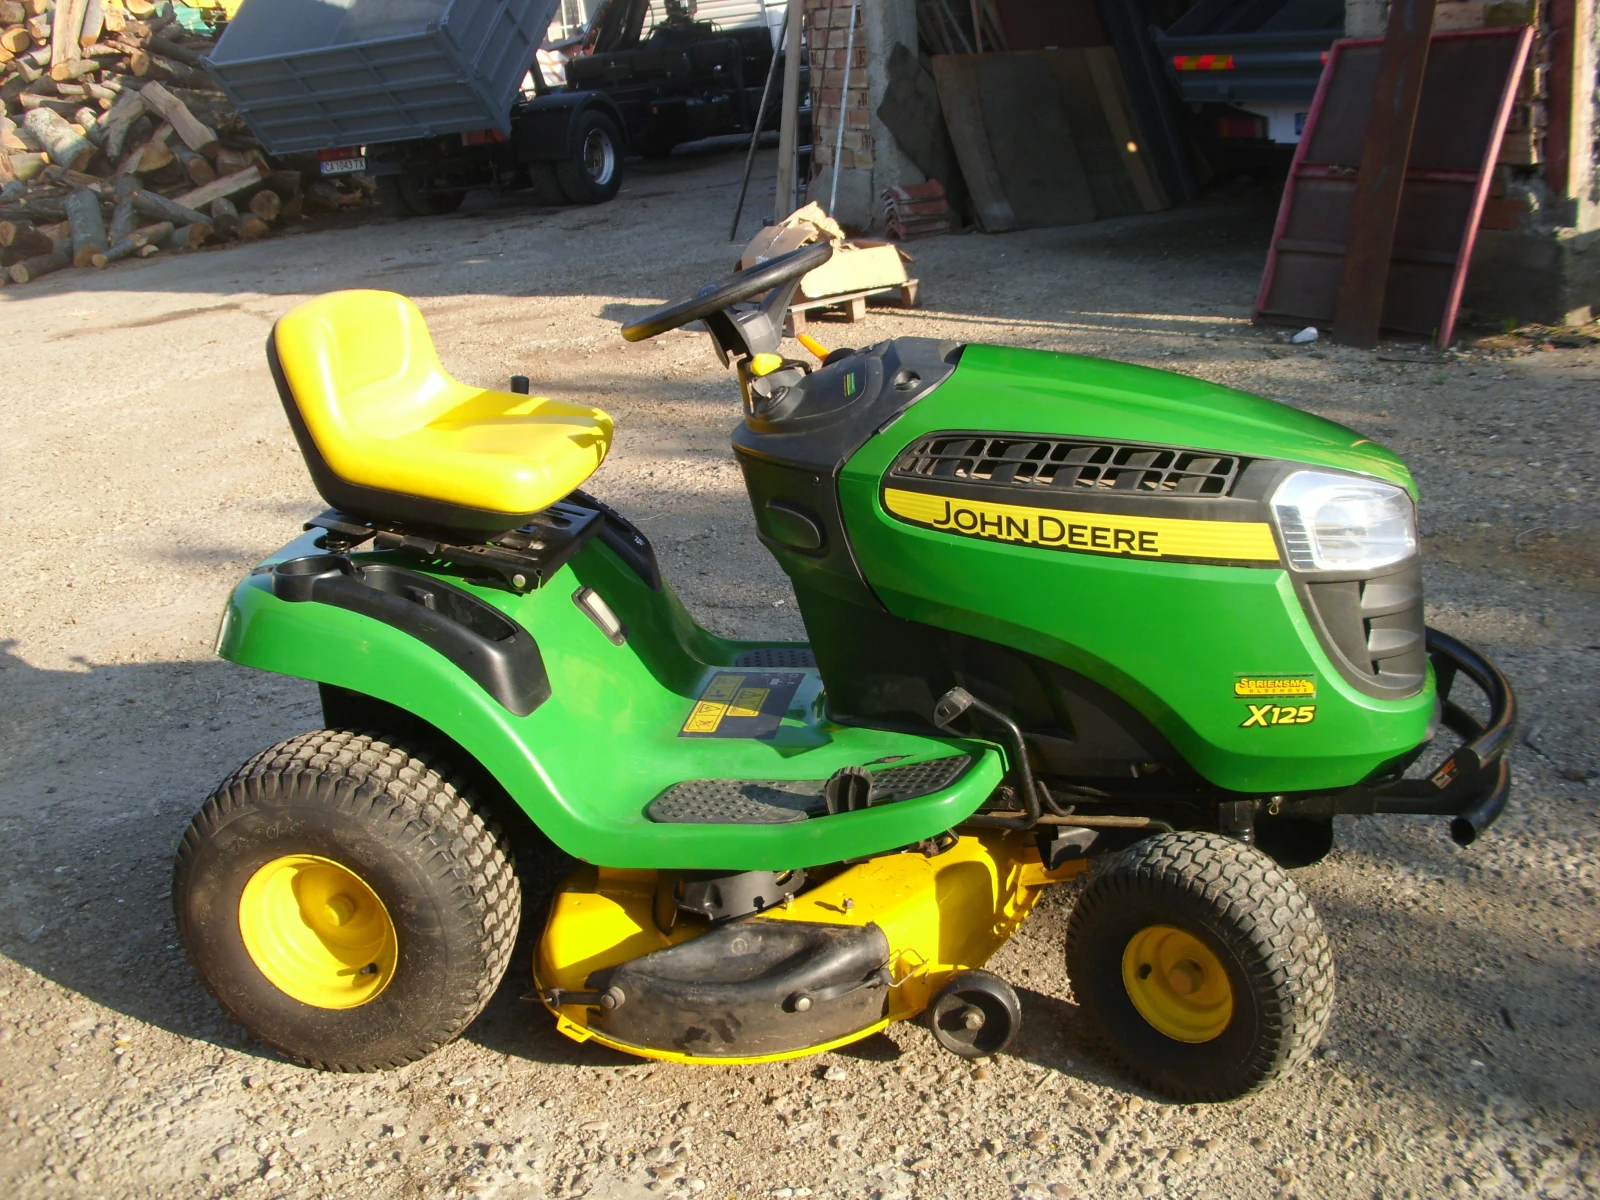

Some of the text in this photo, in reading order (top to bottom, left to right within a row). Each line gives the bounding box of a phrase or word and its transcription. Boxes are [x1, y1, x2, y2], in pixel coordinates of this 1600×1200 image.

[336, 160, 353, 171] 1043
[933, 500, 1159, 553] JOHN DEERE
[1239, 678, 1306, 689] SPRIENSMA
[1239, 704, 1316, 727] X125
